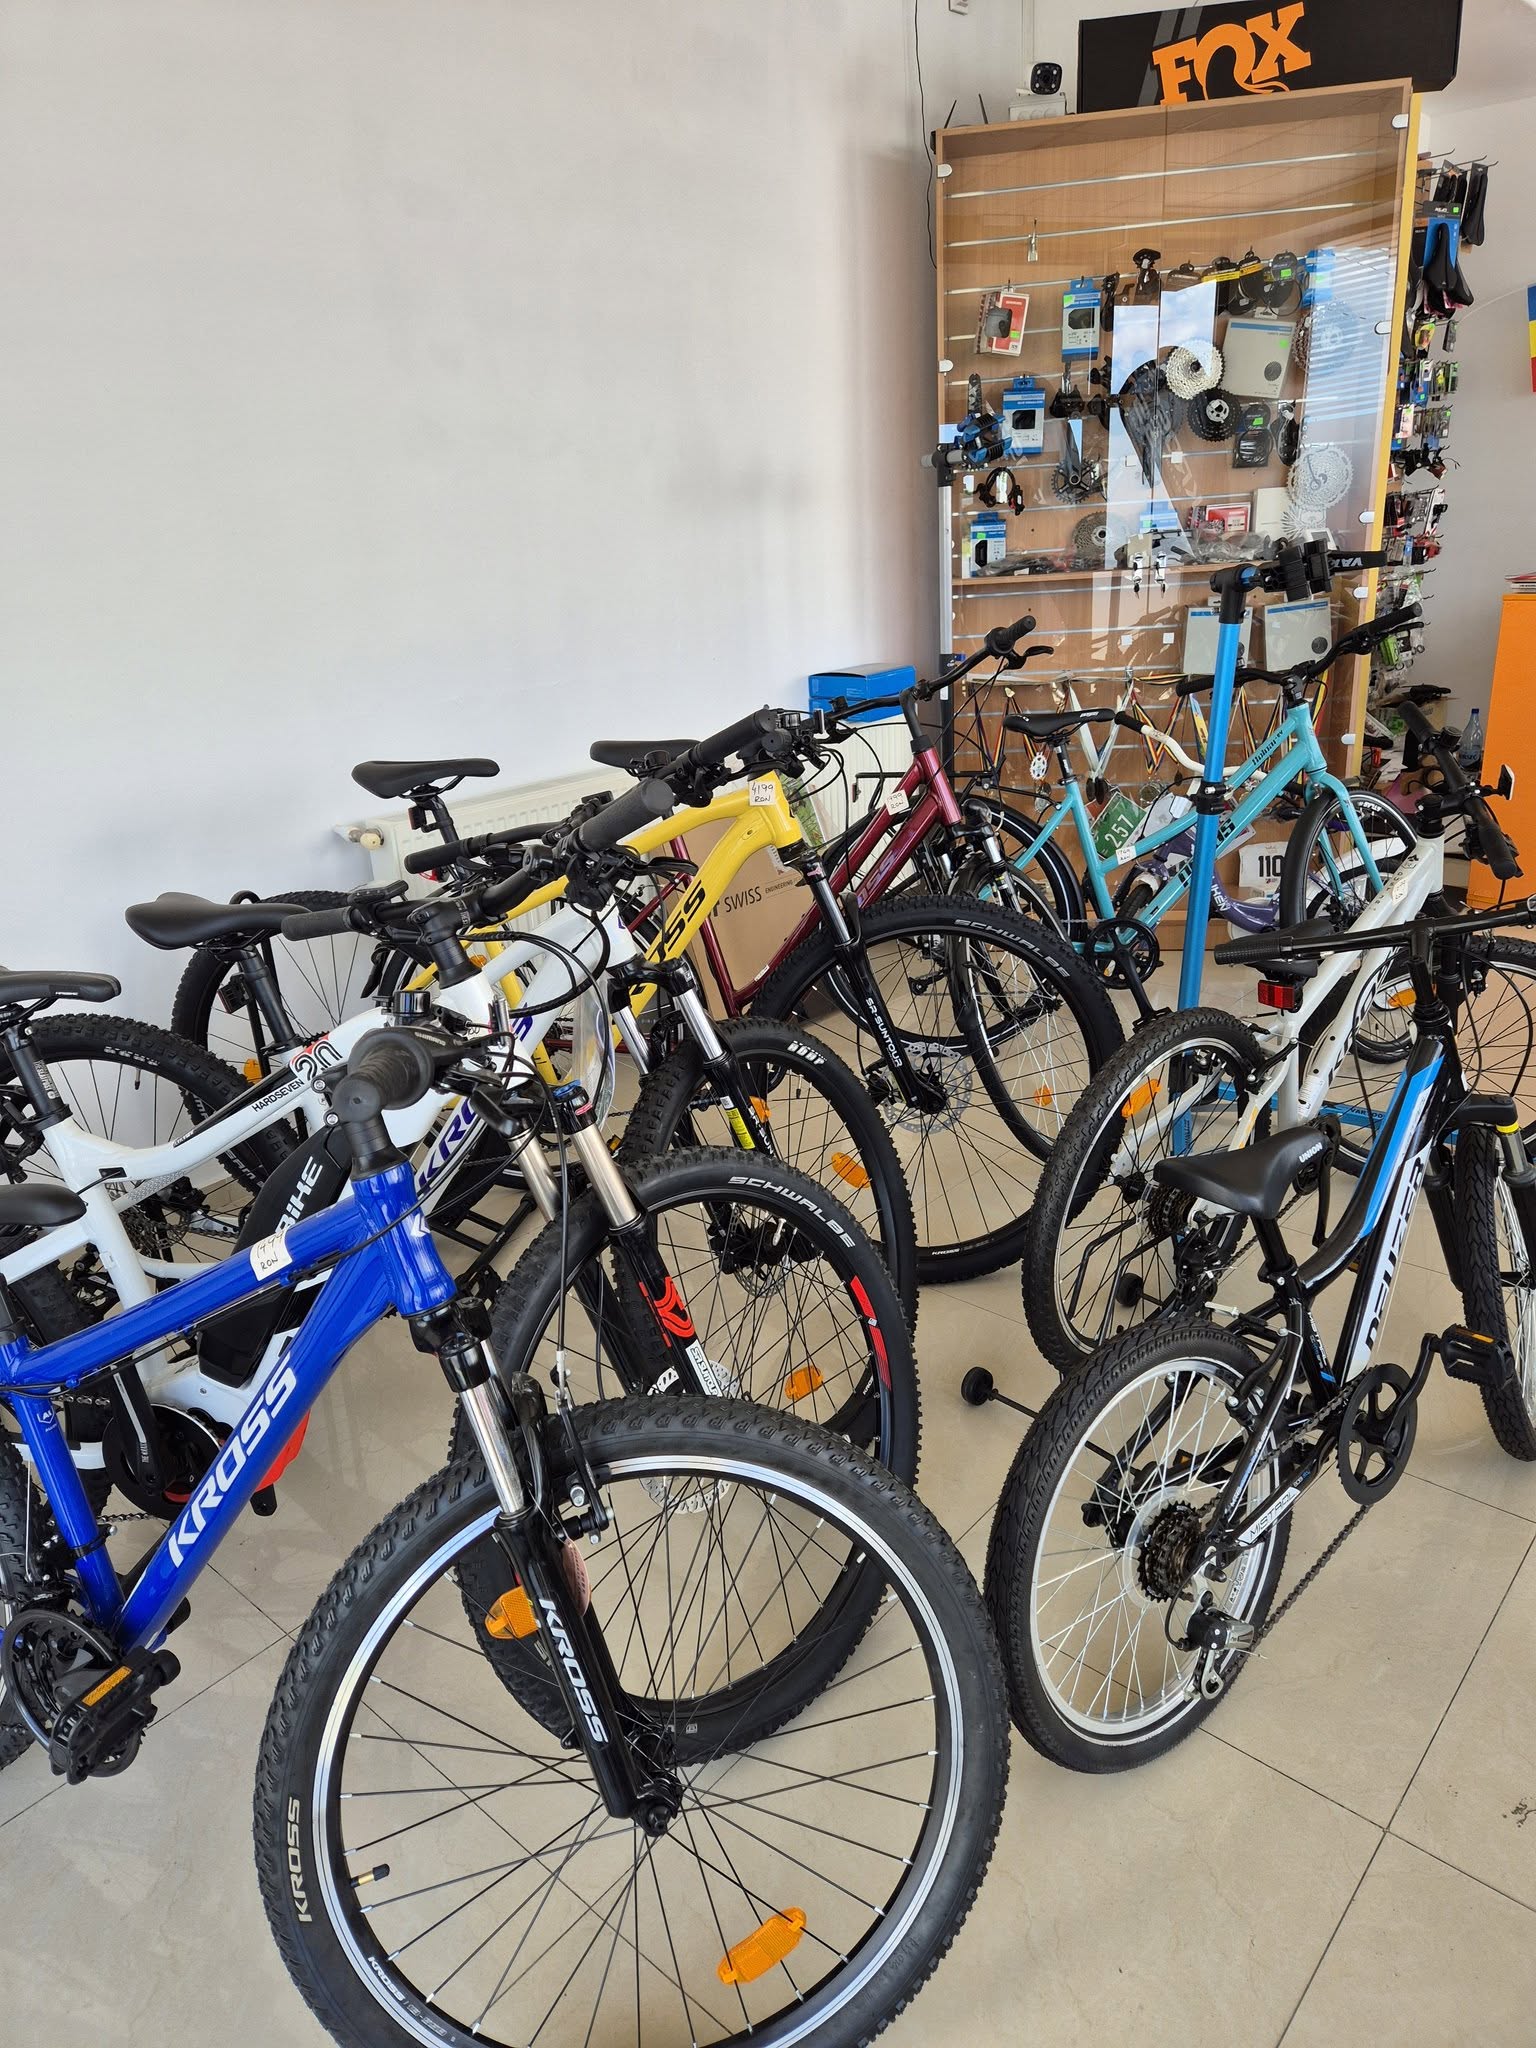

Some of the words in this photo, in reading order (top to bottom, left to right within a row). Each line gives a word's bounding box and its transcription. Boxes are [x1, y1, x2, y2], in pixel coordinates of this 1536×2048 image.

[1152, 2, 1312, 105] FOX
[1104, 814, 1134, 849] 257
[724, 886, 762, 913] SWISS
[765, 879, 794, 894] ENGINEERING
[954, 919, 1070, 977] SCHWALBE
[415, 1031, 446, 1046] SHIMANO
[251, 1078, 305, 1112] HARDSEVEN
[1299, 1142, 1323, 1164] UNION
[728, 1176, 856, 1248] SCHWALBE
[168, 1364, 297, 1568] KROSS
[539, 1599, 609, 1743] KROSS
[286, 1796, 312, 1923] KROSS
[368, 1957, 406, 2001] KROSS
